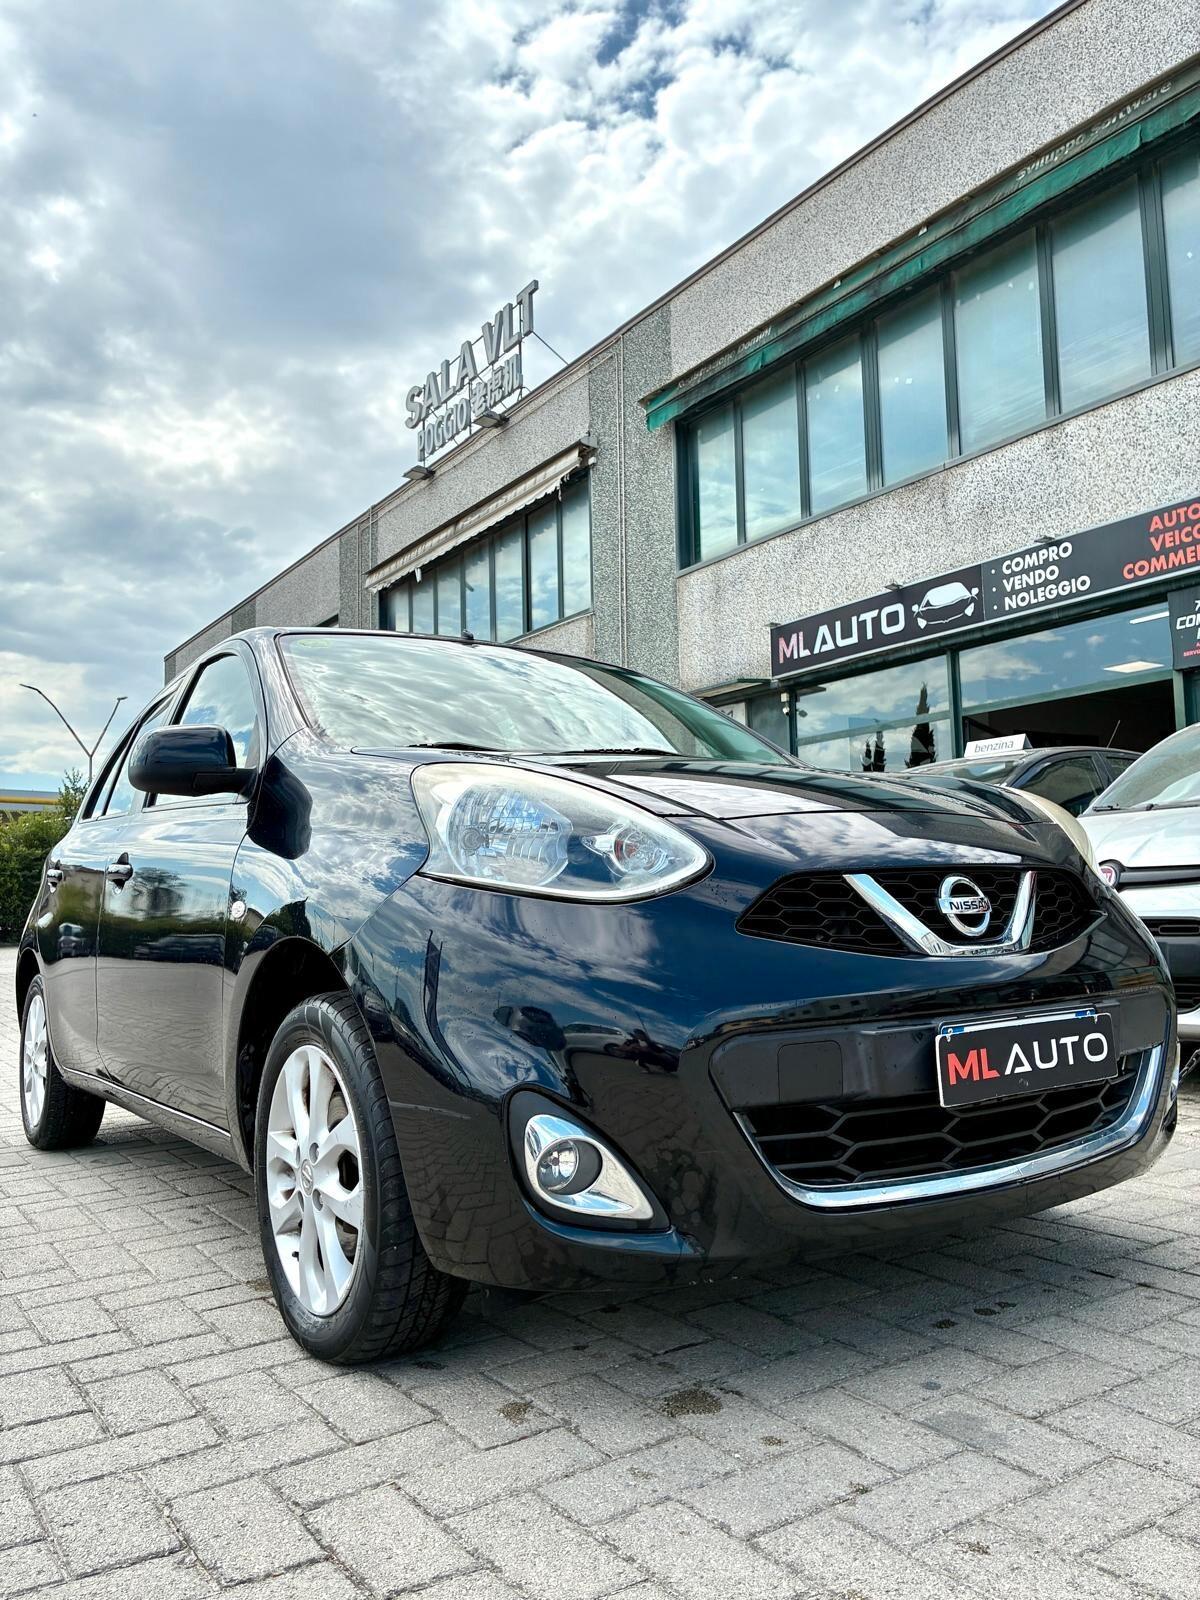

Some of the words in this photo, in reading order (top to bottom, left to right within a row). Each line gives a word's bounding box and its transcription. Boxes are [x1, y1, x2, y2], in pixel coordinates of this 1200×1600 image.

[405, 340, 478, 430] SALA
[481, 279, 540, 366] VLT
[417, 397, 472, 462] POGGIO
[470, 353, 524, 417] 老虎机
[1002, 541, 1073, 575] COMPRO
[1123, 544, 1200, 579] COMME
[1002, 564, 1060, 592] VENDO
[1004, 575, 1091, 611] NOLEGGIO
[974, 740, 1014, 753] benzina
[947, 1047, 1001, 1086] ML
[1004, 1032, 1109, 1076] AUTO
